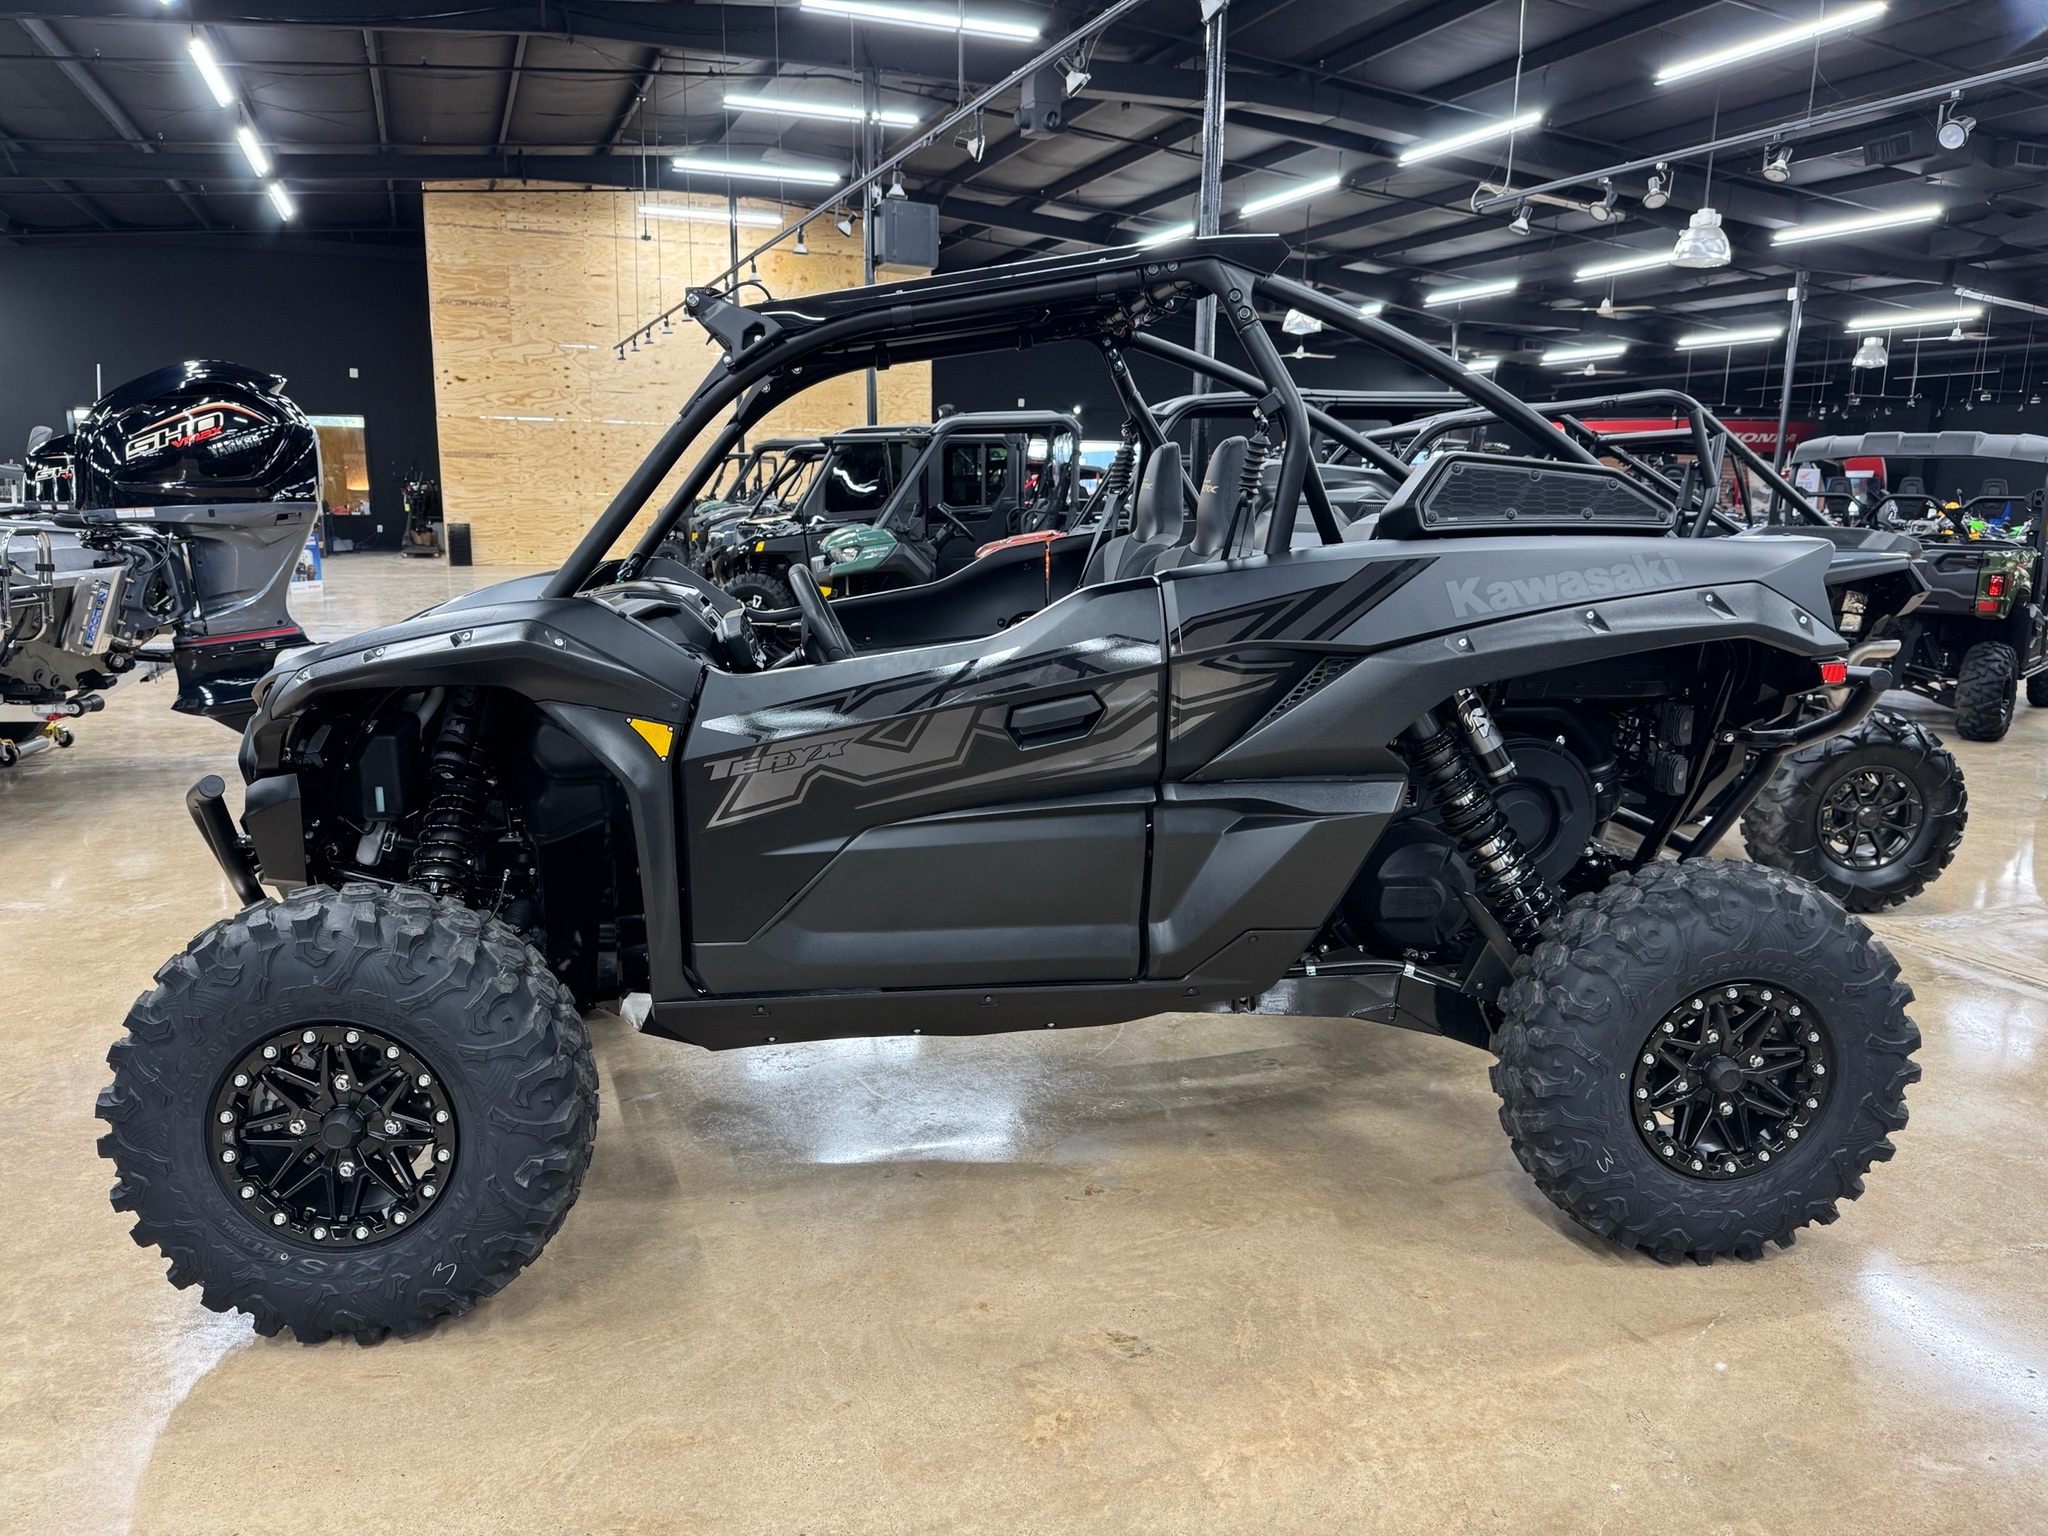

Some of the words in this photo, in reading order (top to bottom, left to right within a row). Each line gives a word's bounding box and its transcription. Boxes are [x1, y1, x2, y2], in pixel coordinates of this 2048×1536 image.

[125, 411, 224, 460] SHO
[1733, 432, 1797, 443] ONA
[35, 465, 75, 481] SH
[1445, 551, 1685, 619] Kawasaki
[703, 738, 853, 781] TERYX
